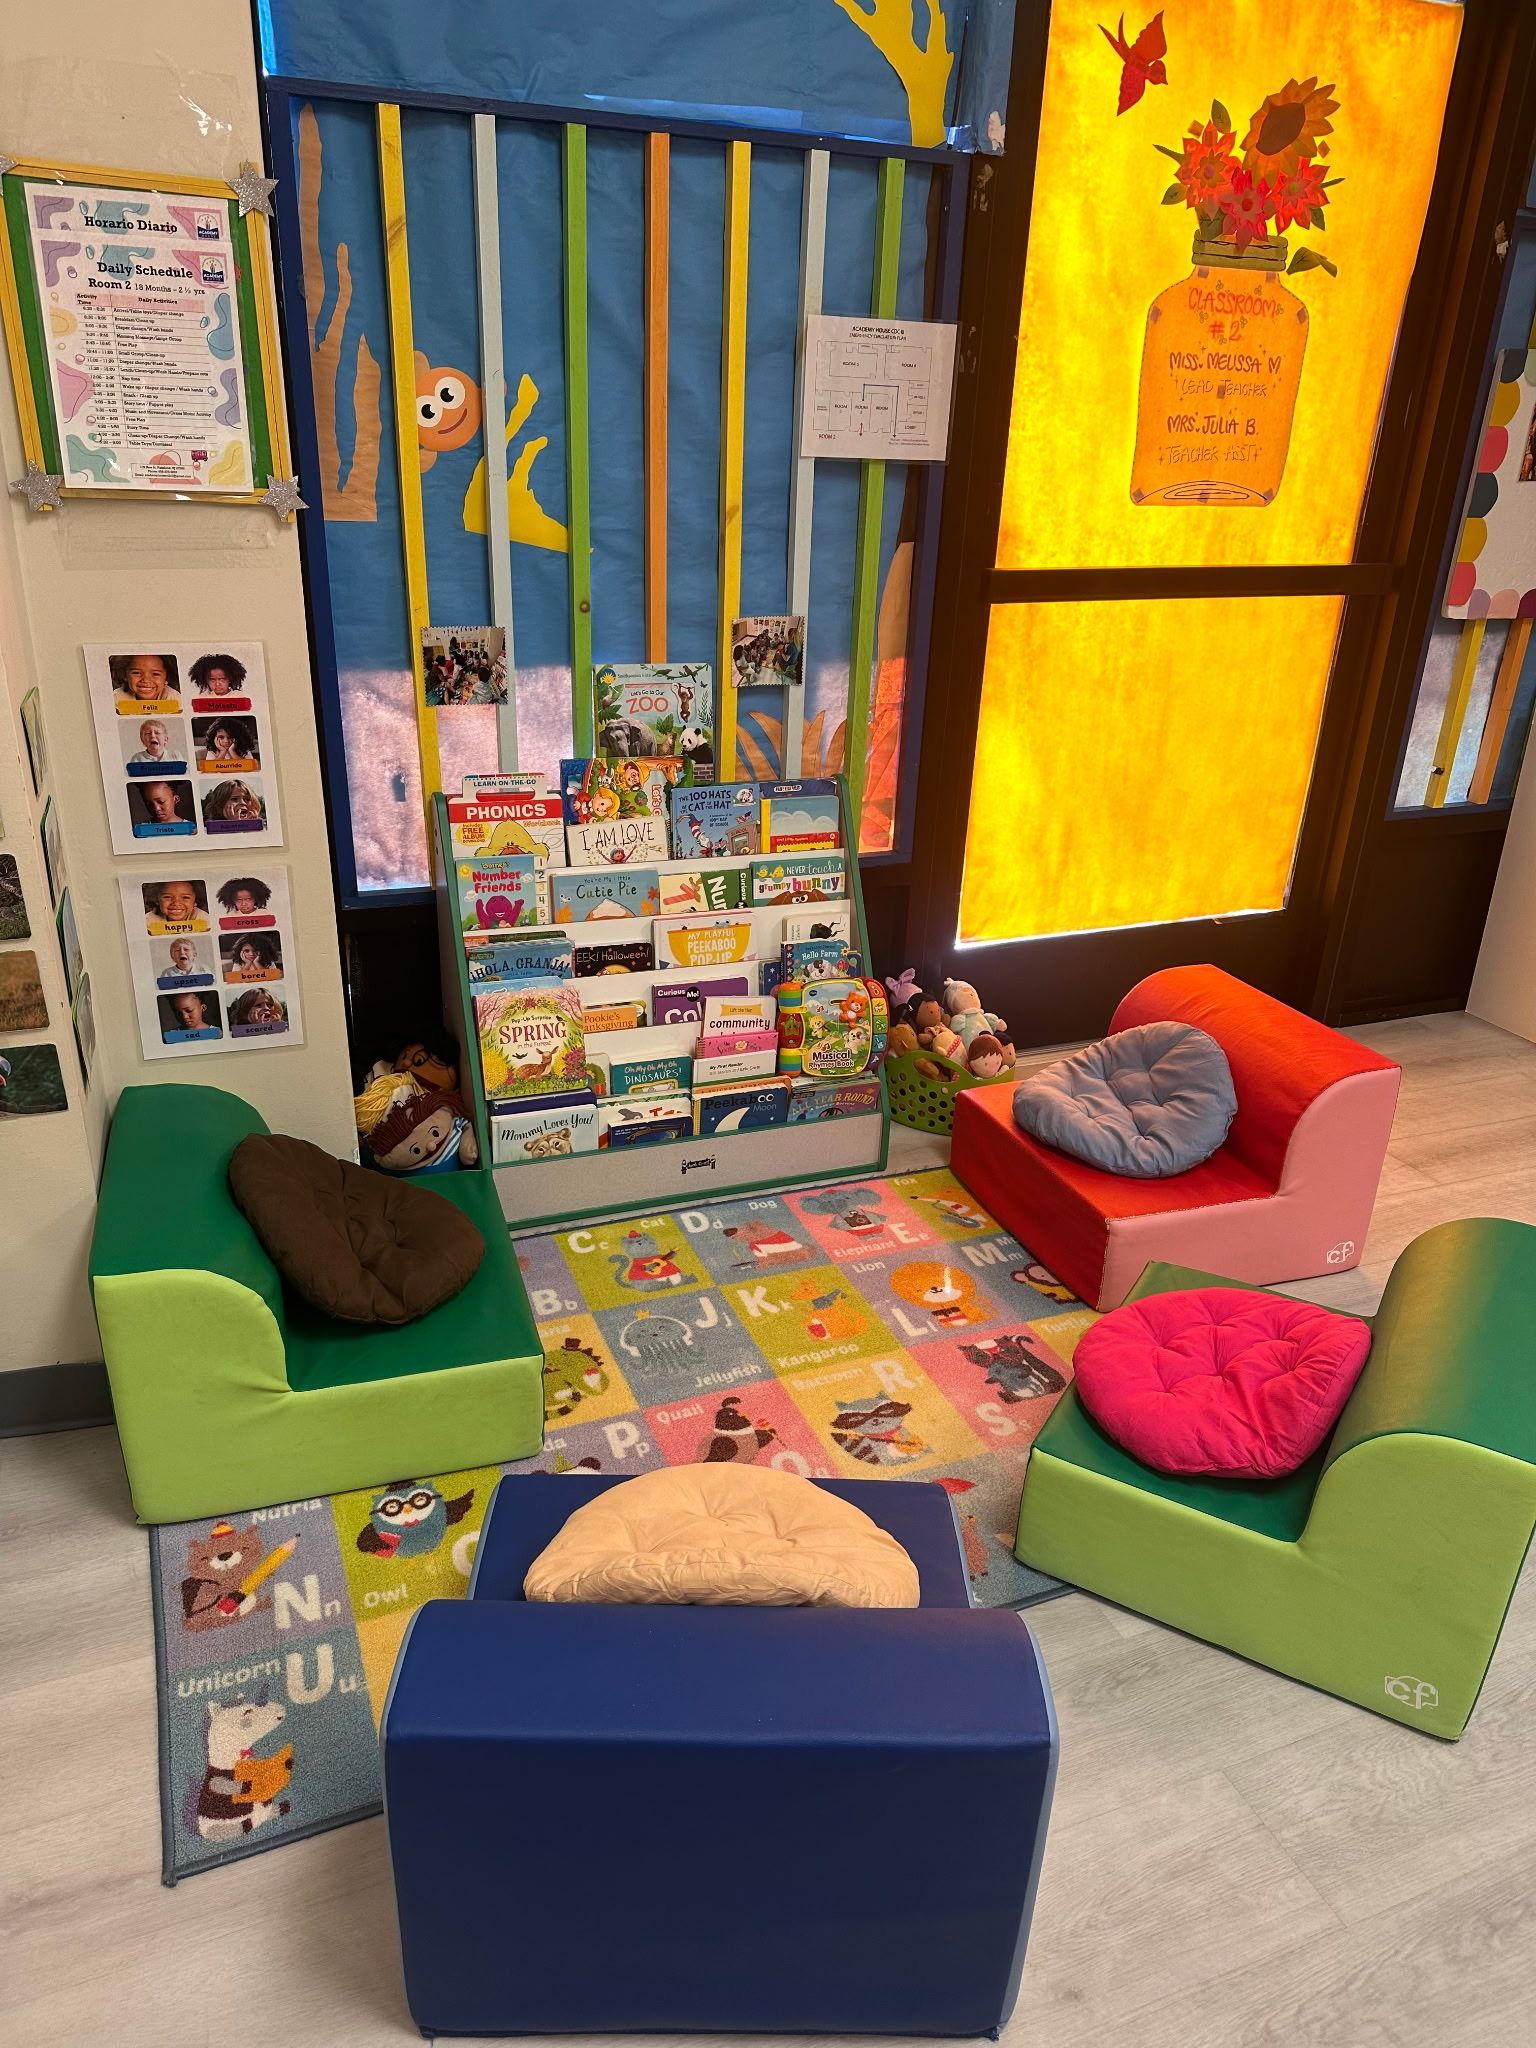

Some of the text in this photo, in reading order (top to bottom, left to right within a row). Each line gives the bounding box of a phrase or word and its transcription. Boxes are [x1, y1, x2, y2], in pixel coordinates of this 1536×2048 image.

[84, 215, 178, 233] Horario Diario
[97, 261, 193, 279] Daily Schedule
[88, 278, 123, 290] Room
[124, 280, 132, 290] 2
[135, 283, 144, 291] 18
[145, 284, 172, 293] Months
[193, 288, 206, 296] yrs
[1188, 287, 1276, 318] CLASSROOM
[1229, 320, 1242, 341] 2
[1207, 353, 1262, 374] MELISSA
[1181, 378, 1268, 398] LEAD TEACHER
[1167, 414, 1201, 434] MRS.
[1202, 415, 1239, 435] JULIA
[1165, 445, 1219, 464] TEACHER
[142, 703, 159, 711] Feliz
[626, 696, 669, 714] ZOO
[215, 762, 243, 770] Aburrido
[473, 780, 497, 788] LEARN
[652, 784, 662, 807] Let's
[690, 791, 707, 801] 100
[709, 789, 731, 800] HATS
[466, 803, 547, 820] PHONICS
[688, 801, 731, 812] CAT HAT
[462, 833, 485, 841] ALBUM
[578, 822, 656, 851] I AM LOVE
[472, 870, 522, 883] Number
[538, 870, 545, 880] 2
[787, 865, 806, 875] NEVER
[808, 860, 837, 875] touch
[474, 881, 522, 893] Friends
[576, 881, 638, 899] Cutie Pie
[758, 873, 845, 894] grumpy bunny!
[538, 896, 545, 905] 4
[236, 918, 260, 927] cross
[539, 909, 545, 918] 5
[164, 923, 193, 932] happy
[687, 929, 735, 940] MY PLAYFUL
[688, 938, 737, 955] PEEKABOO
[801, 950, 839, 960] Hello Farm
[577, 949, 650, 963] EEK! Halloween!
[517, 958, 571, 973] GRANJA!
[173, 977, 199, 987] upset
[241, 970, 267, 980] bored
[657, 989, 686, 997] Curious
[531, 1014, 552, 1022] Surprise
[584, 1011, 620, 1024] Pookie's
[584, 1019, 634, 1032] anksgiving
[709, 1018, 771, 1031] community
[184, 1031, 201, 1040] sad
[246, 1024, 274, 1034] scared
[499, 1021, 567, 1045] SPRING
[812, 1050, 850, 1061] Musical
[624, 1066, 635, 1074] Oh
[657, 1061, 668, 1072] My
[668, 1060, 678, 1068] Oh
[809, 1060, 855, 1071] Rhymes Book
[624, 1068, 682, 1086] DINOSAURS!
[704, 1093, 775, 1111] Peekaboo
[753, 1102, 778, 1114] Moon
[815, 1092, 876, 1106] YEAR ROUND
[501, 1113, 594, 1141] Mommy Loves You!
[748, 1199, 778, 1212] Dog
[640, 1216, 667, 1229] Cat
[679, 1211, 711, 1234] D
[888, 1222, 919, 1244] E
[567, 1231, 595, 1254] C
[833, 1237, 896, 1259] Elephant
[960, 1241, 1010, 1268] M
[852, 1259, 887, 1274] Lion
[530, 1289, 563, 1316] B
[736, 1285, 780, 1318] K
[695, 1296, 719, 1329] J
[890, 1307, 928, 1338] L
[776, 1343, 860, 1368] Kangaroo
[693, 1363, 764, 1389] Jellyfish
[870, 1359, 917, 1393] R
[654, 1402, 706, 1425] Quail
[976, 1401, 1018, 1437] S
[602, 1420, 641, 1460] P
[251, 1498, 324, 1525] Nutria
[273, 1573, 343, 1631] N n
[363, 1582, 410, 1610] Owl
[175, 1657, 281, 1699] Unicorn
[285, 1643, 336, 1706] U
